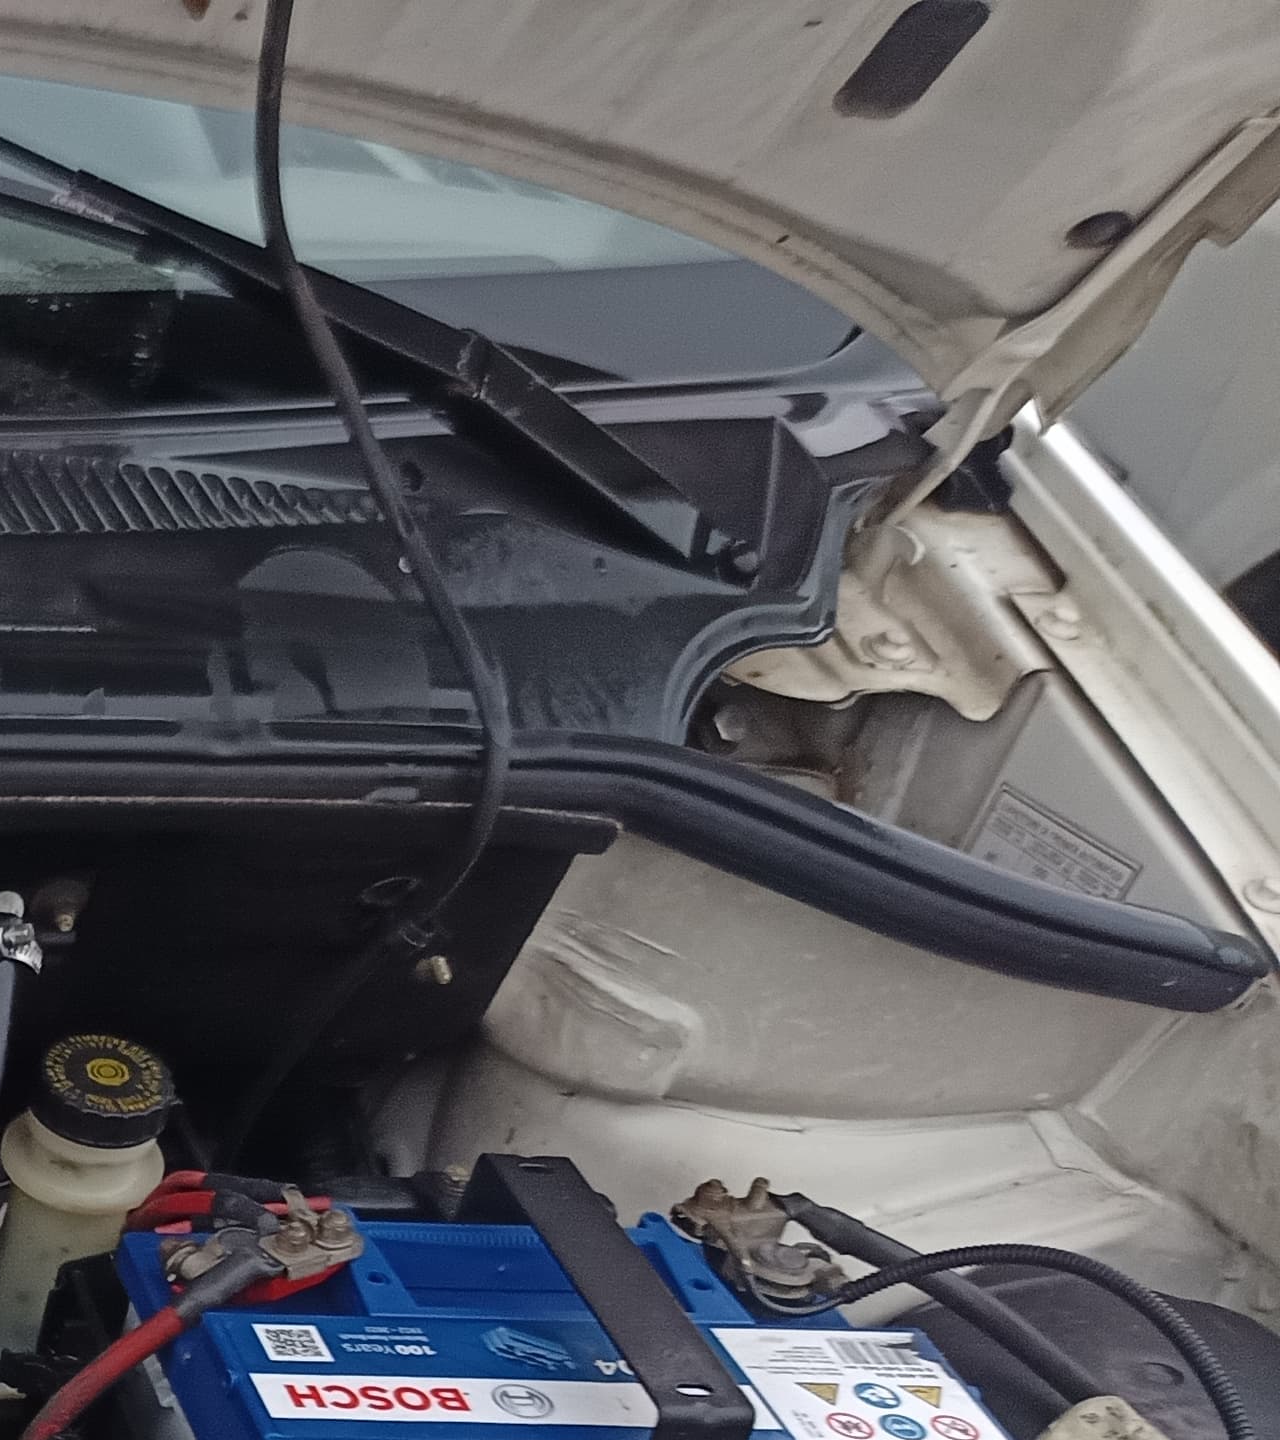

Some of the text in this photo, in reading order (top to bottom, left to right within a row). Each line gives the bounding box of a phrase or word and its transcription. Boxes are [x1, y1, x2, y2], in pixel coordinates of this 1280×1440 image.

[342, 1344, 437, 1356] 100 Years
[288, 1383, 471, 1412] BOSCH
